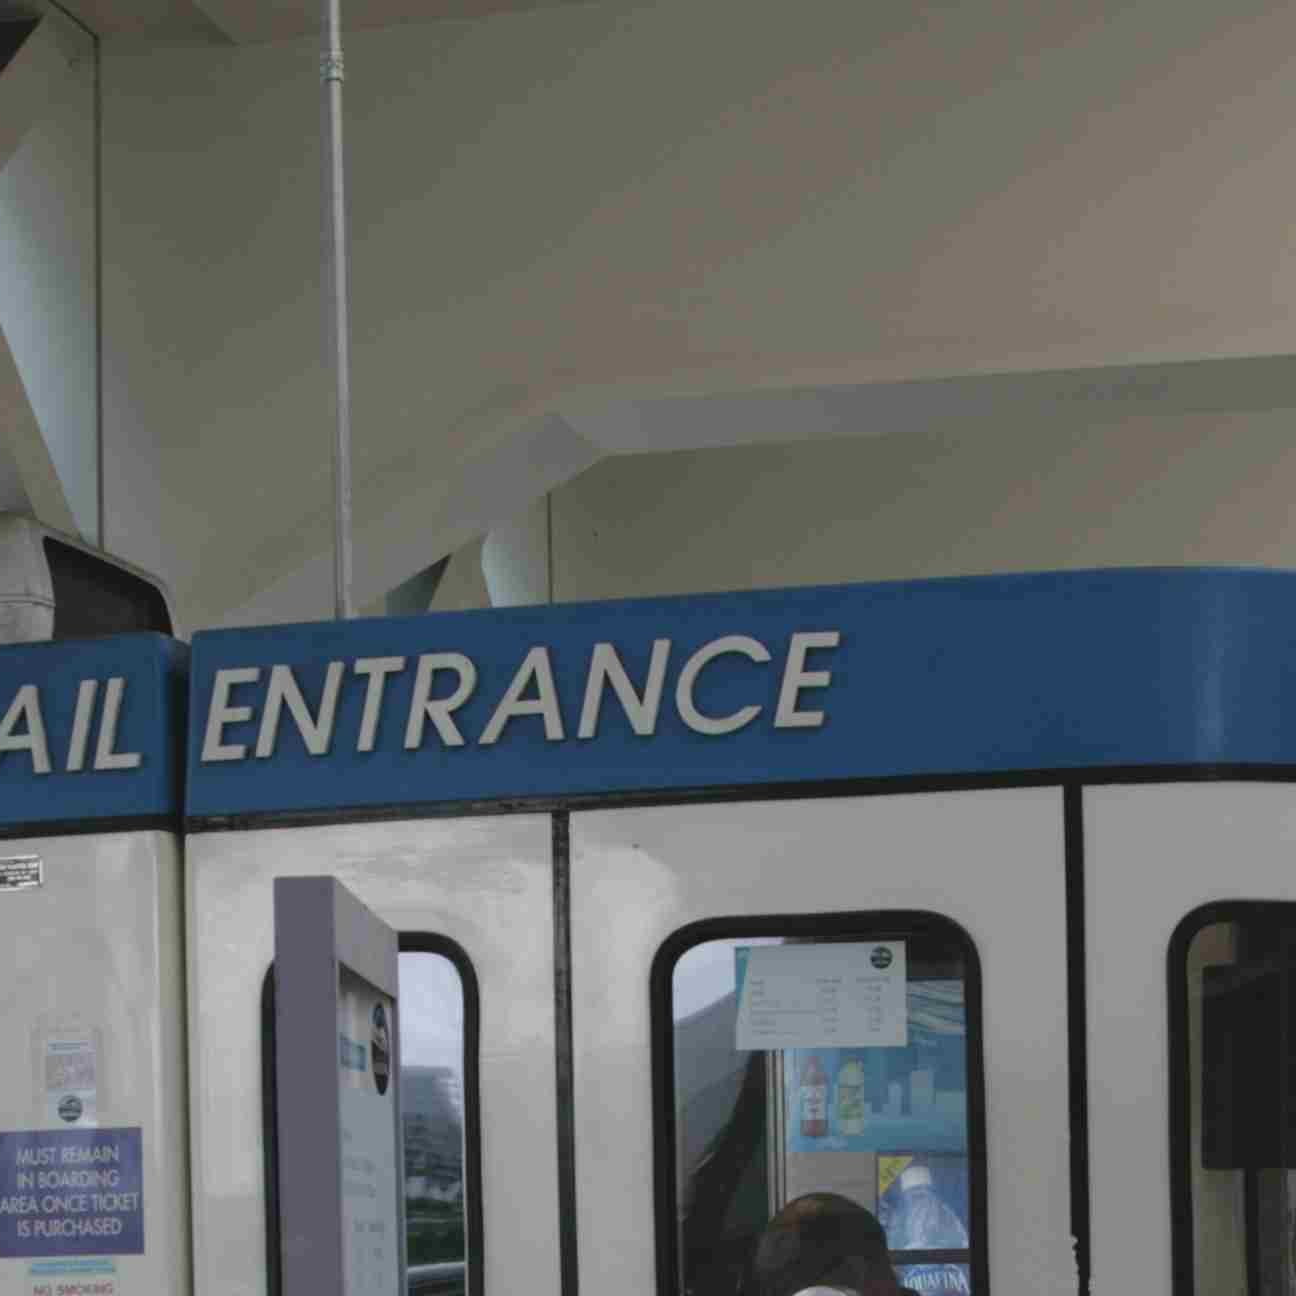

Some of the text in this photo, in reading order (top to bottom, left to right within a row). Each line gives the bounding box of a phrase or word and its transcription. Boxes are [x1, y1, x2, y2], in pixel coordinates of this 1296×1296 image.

[200, 631, 840, 762] ENTRANCE
[16, 1144, 120, 1166] MUST REMAIN
[17, 1168, 120, 1190] IN BOARDING
[0, 1192, 139, 1215] AREA ONCE TICKET
[17, 1216, 123, 1238] IS PURCHASED
[33, 1280, 114, 1296] NO SMOKING
